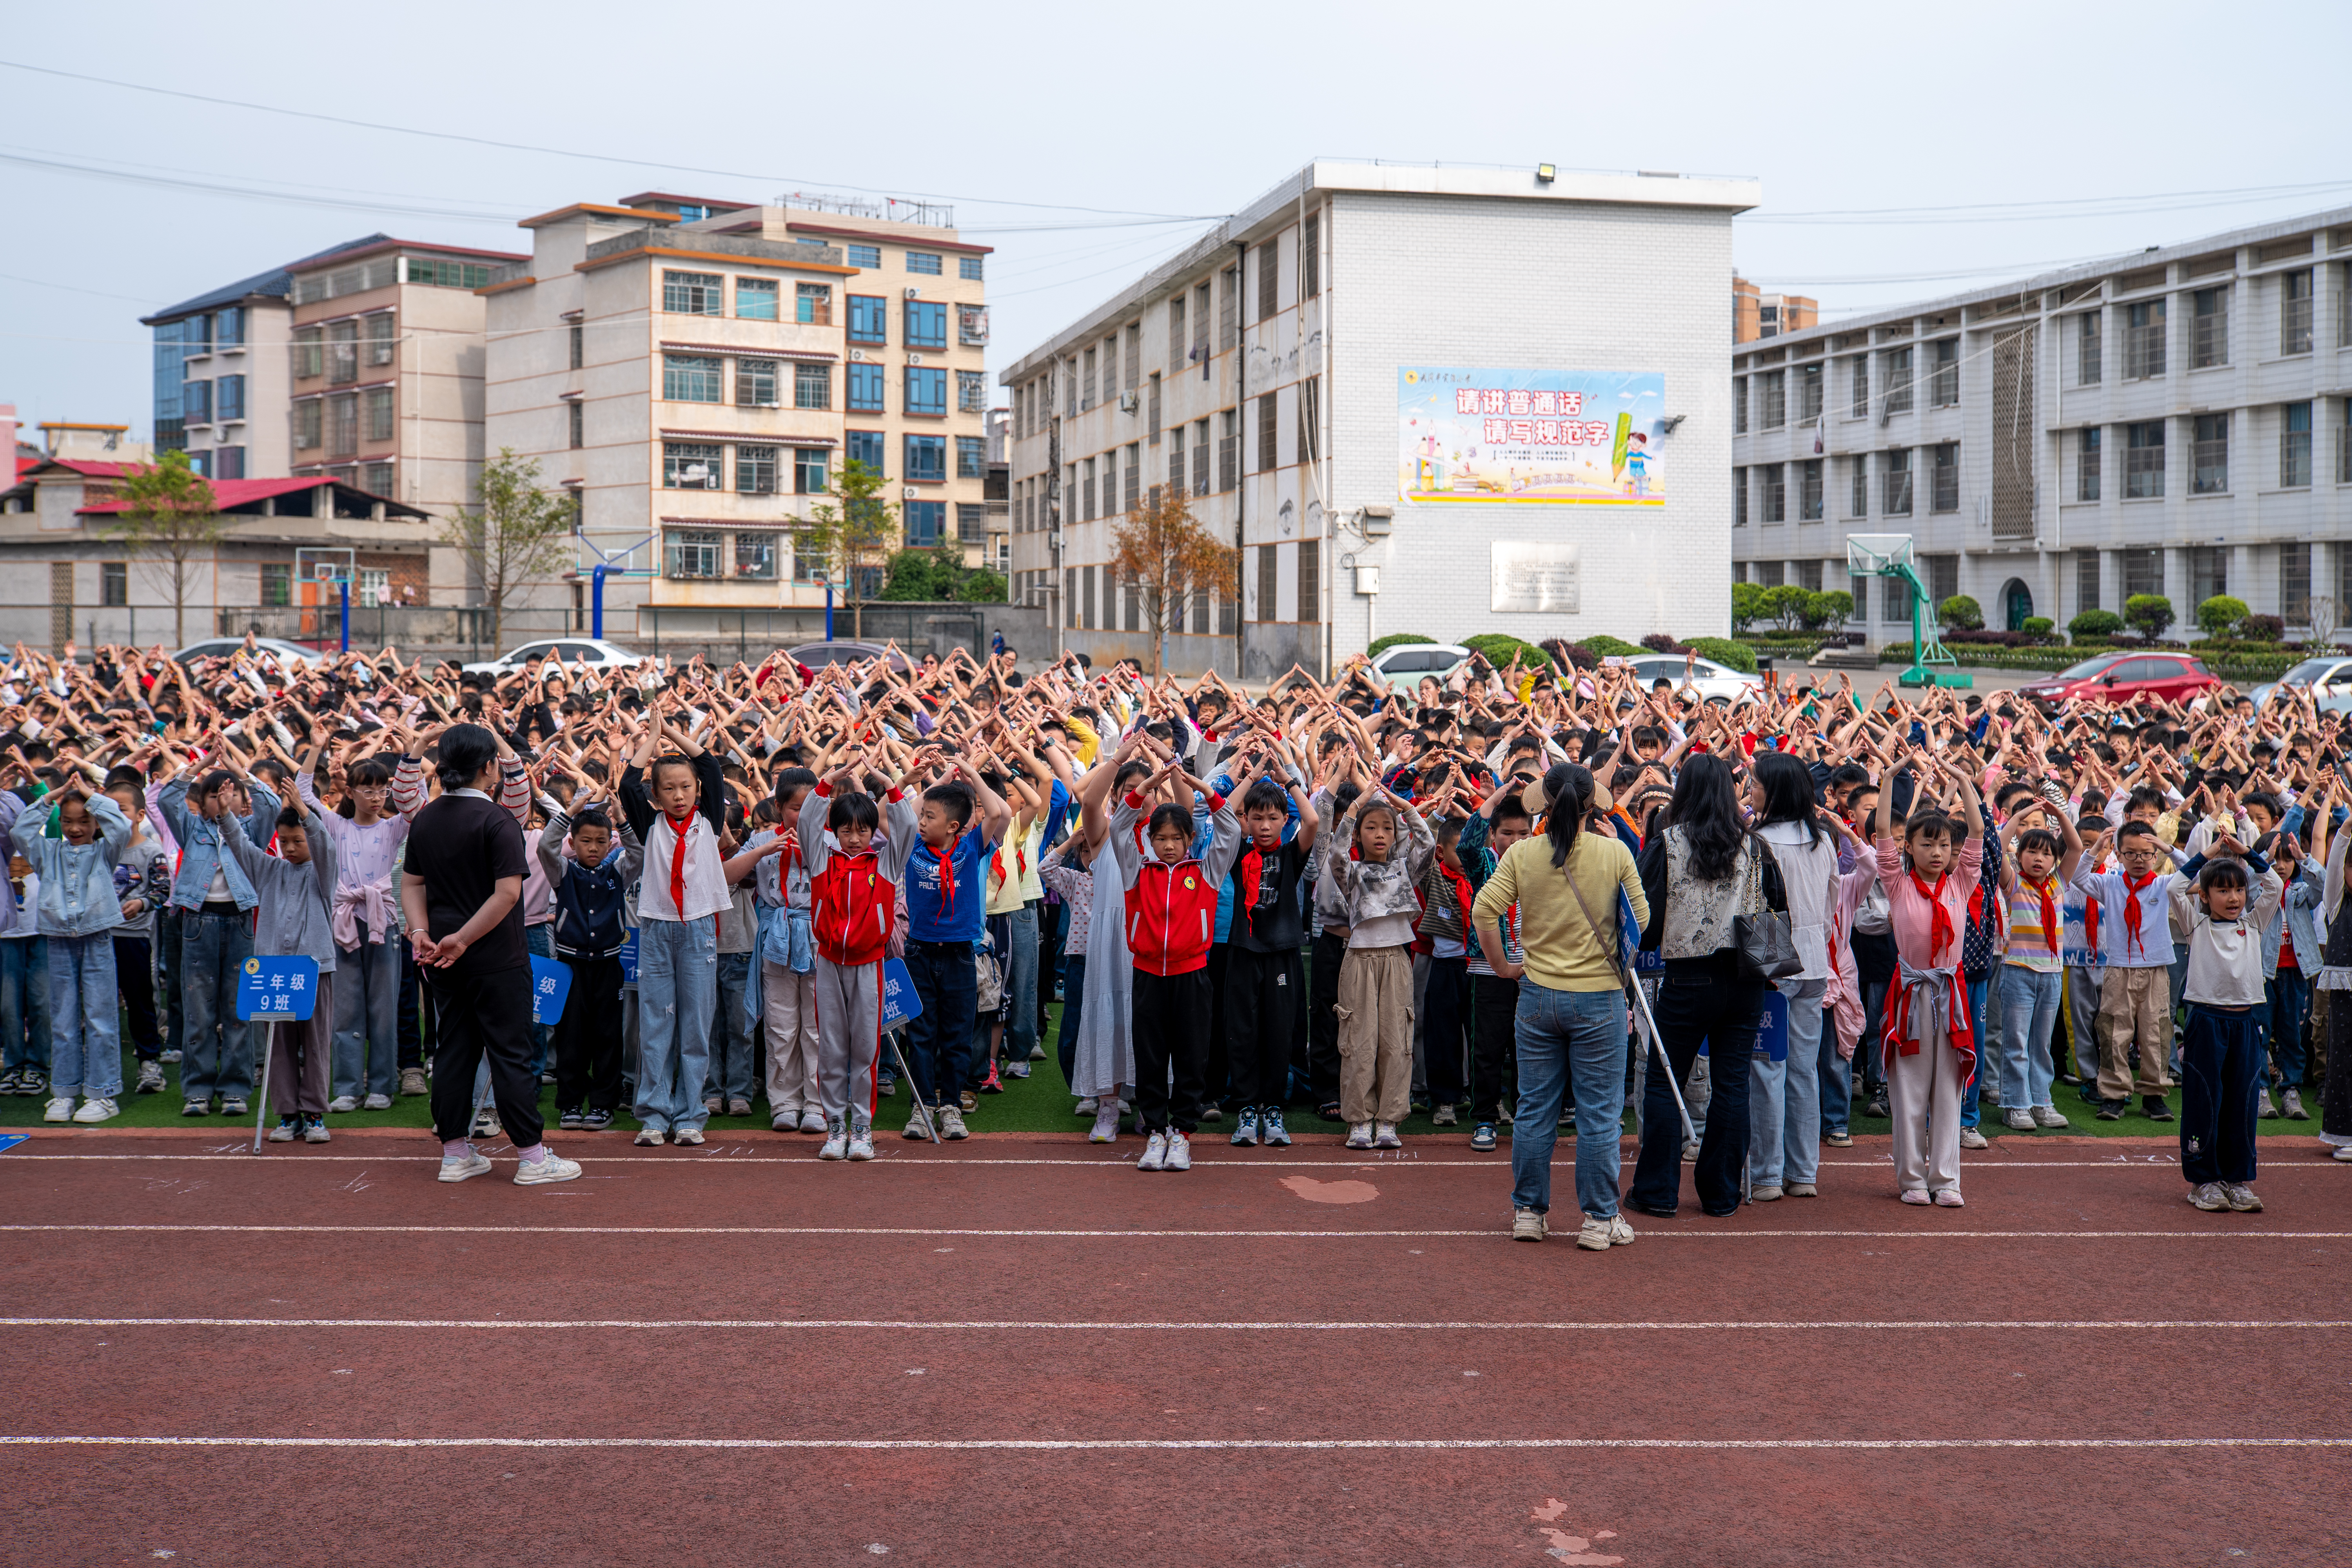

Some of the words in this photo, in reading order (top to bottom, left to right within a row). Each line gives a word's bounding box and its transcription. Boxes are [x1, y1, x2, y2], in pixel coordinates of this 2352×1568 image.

[1456, 388, 1582, 416] 请讲普通话
[1484, 418, 1609, 446] 请写规范字
[918, 881, 936, 890] PAUL
[249, 973, 305, 991] 三年级
[260, 994, 290, 1011] 9班
[884, 1000, 902, 1020] 班
